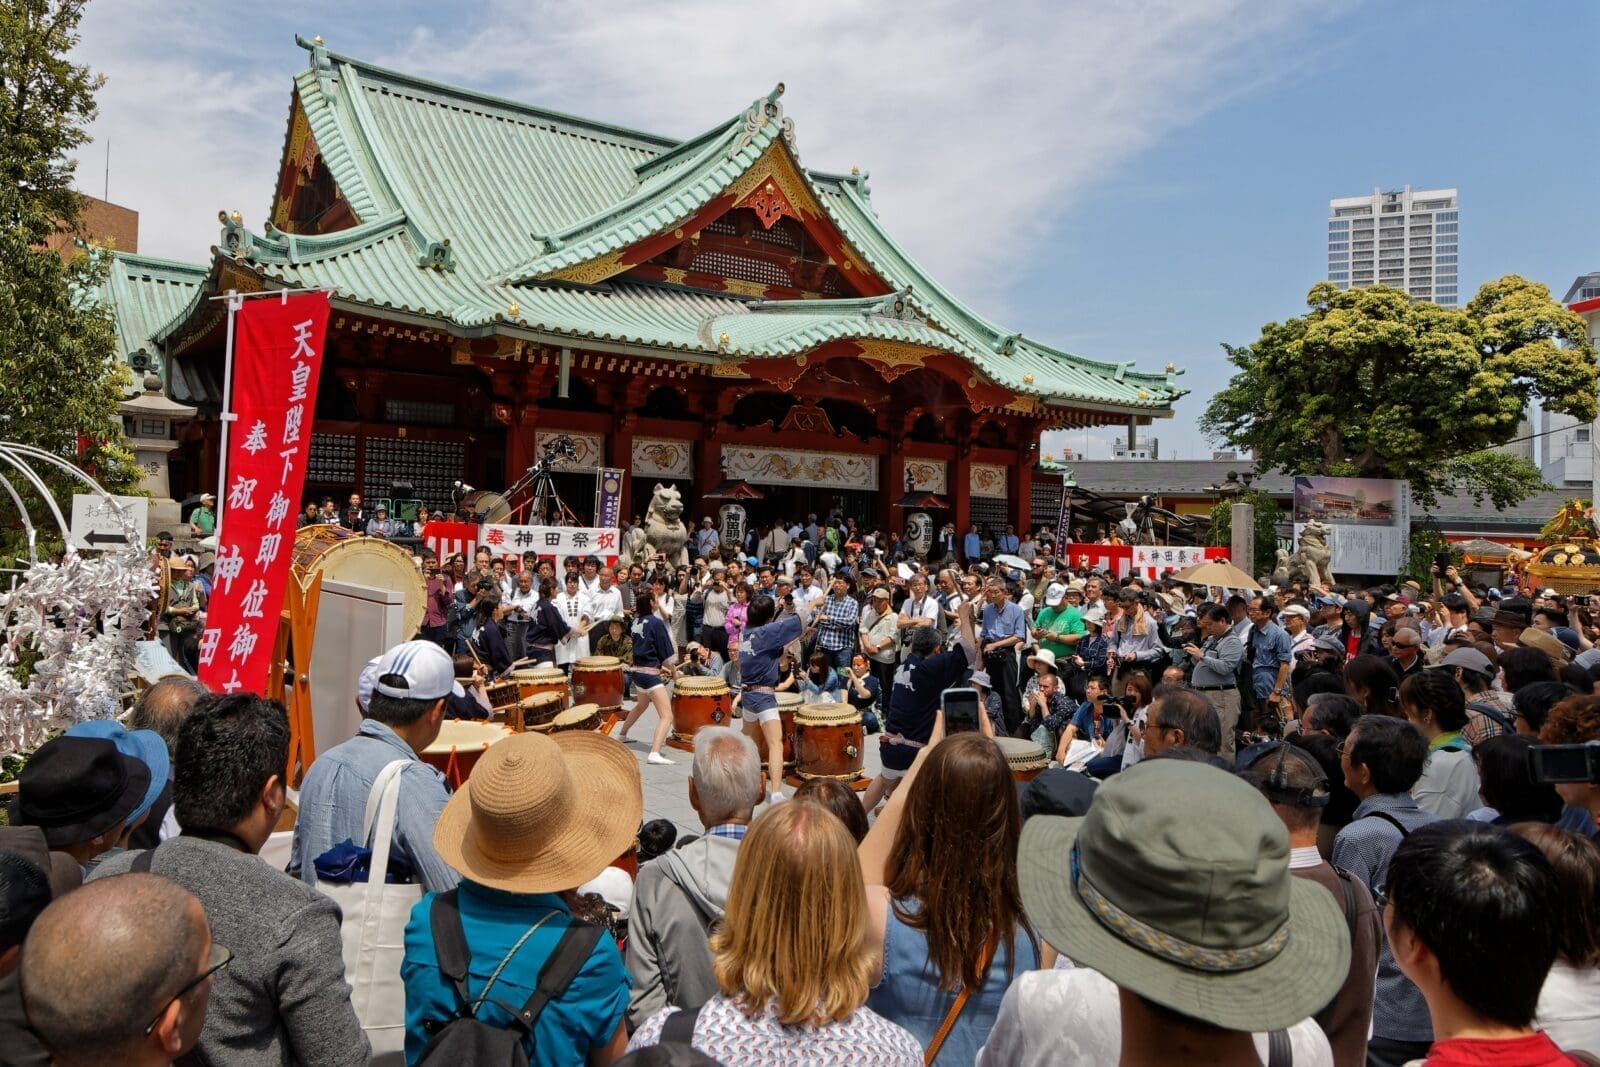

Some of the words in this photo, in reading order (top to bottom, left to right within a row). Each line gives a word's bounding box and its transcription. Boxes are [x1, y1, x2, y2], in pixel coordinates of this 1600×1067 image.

[486, 528, 615, 549] 奉神田祭祝
